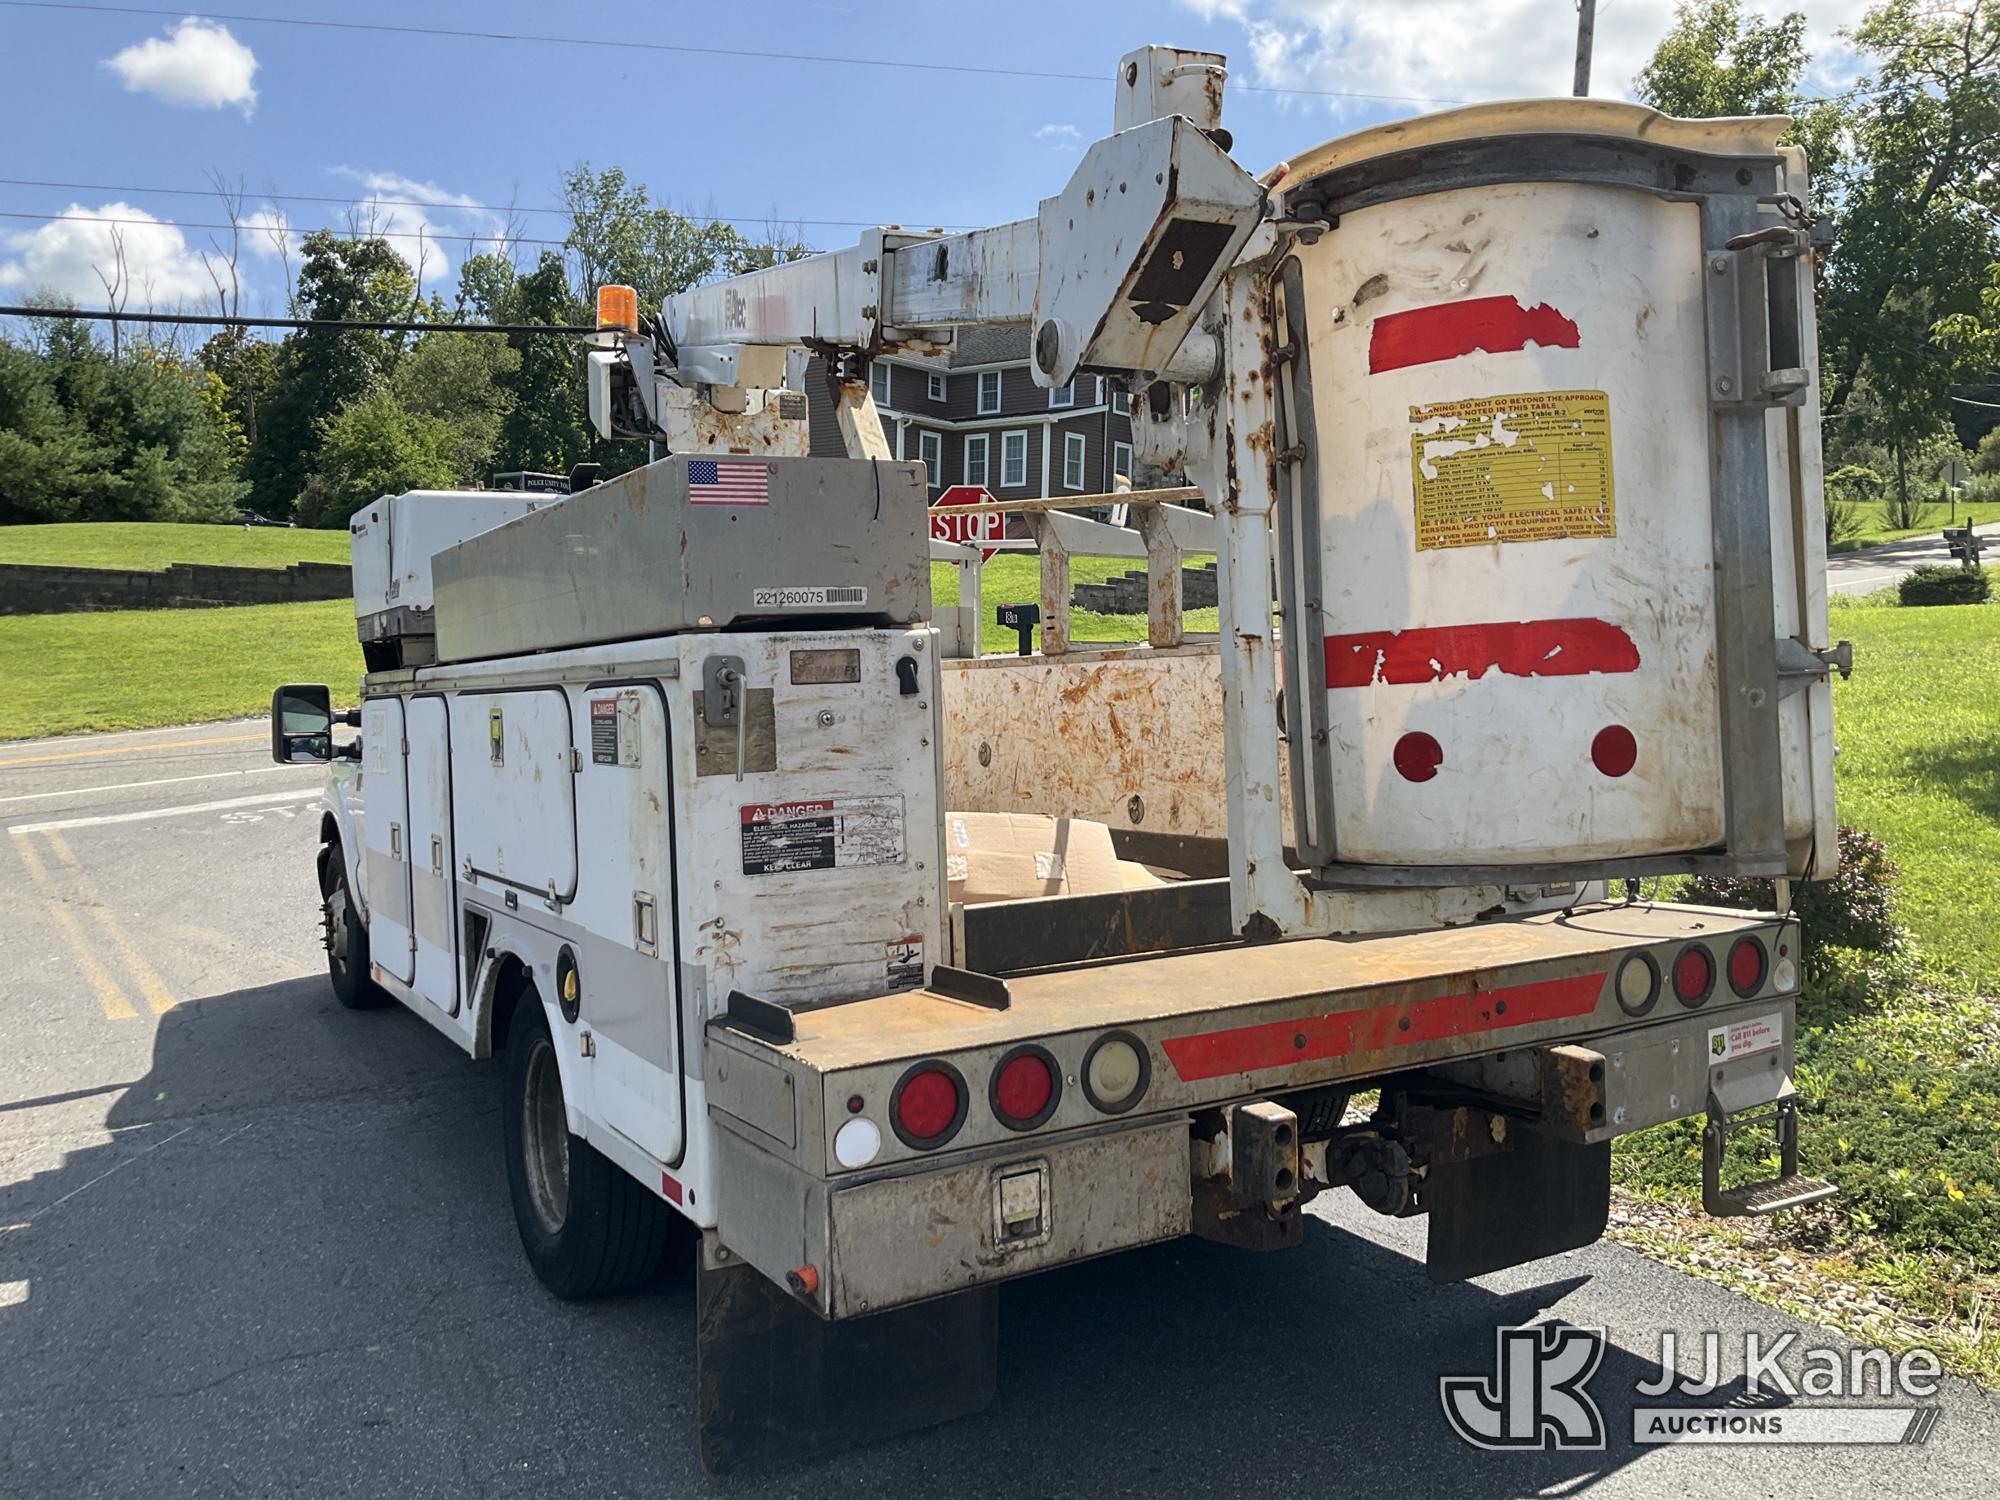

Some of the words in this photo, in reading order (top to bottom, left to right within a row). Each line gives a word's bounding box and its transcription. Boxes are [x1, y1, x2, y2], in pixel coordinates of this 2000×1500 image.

[1415, 404, 1457, 416] WNING:
[1510, 396, 1544, 404] BEYOND
[1465, 408, 1494, 416] NOTED
[1482, 512, 1505, 520] YOUR
[1508, 508, 1560, 518] ELECTRICAL
[936, 512, 1000, 540] STOP
[1421, 526, 1461, 534] PERSONAL
[1464, 520, 1514, 530] PROTECTIVE
[756, 592, 824, 604] 221260075
[786, 861, 812, 870] CLEAR
[1731, 1032, 1742, 1042] Call
[1743, 1030, 1752, 1038] 811
[1752, 1026, 1770, 1036] before
[1732, 1042, 1742, 1052] you
